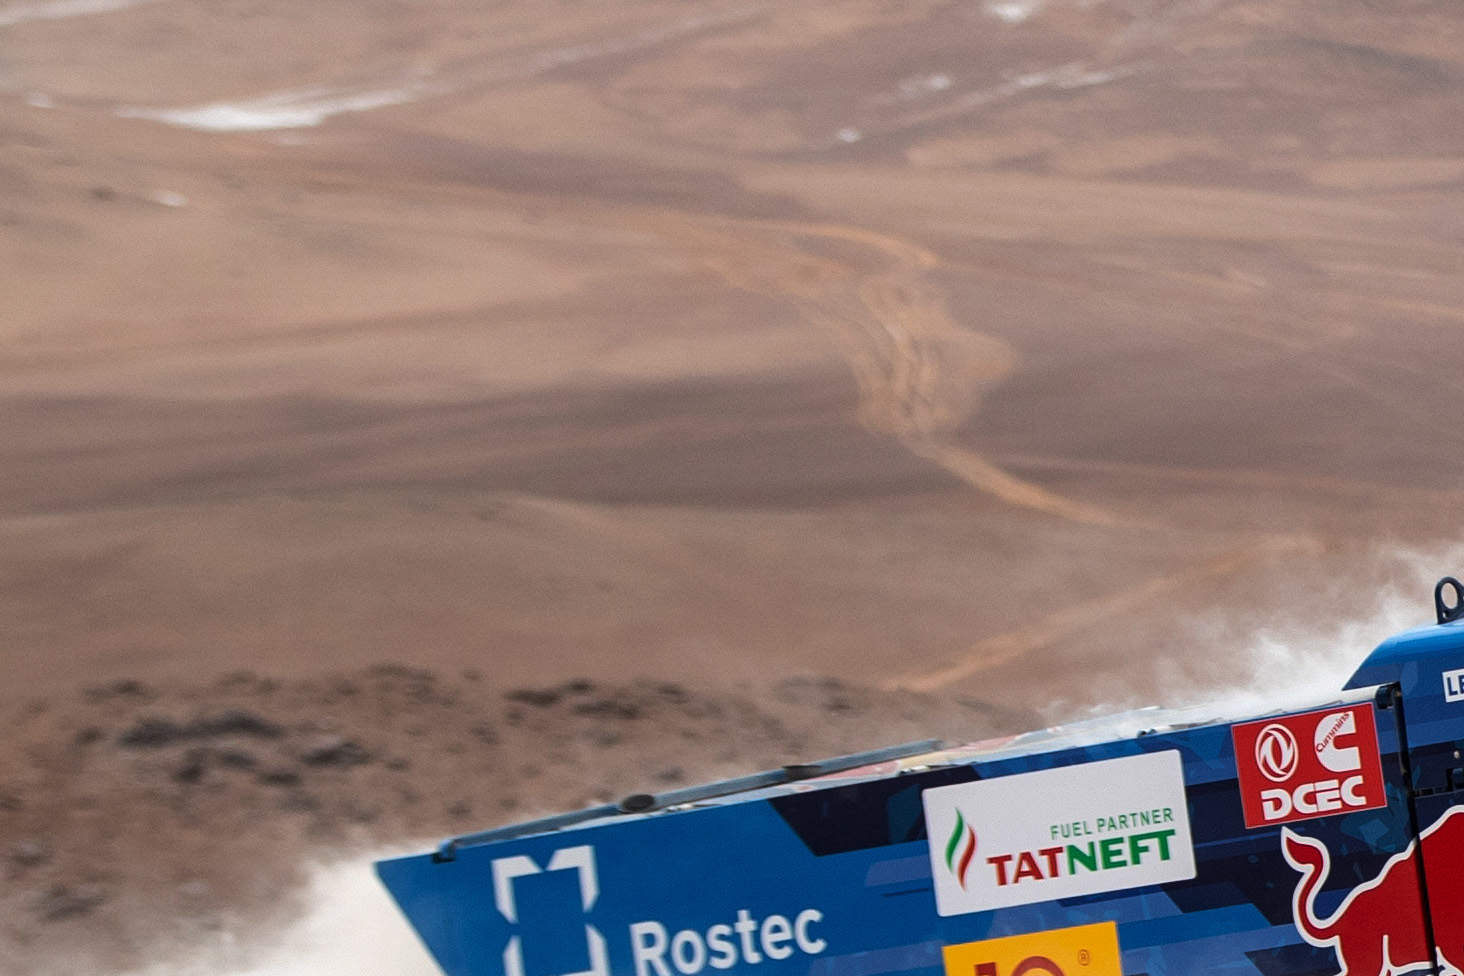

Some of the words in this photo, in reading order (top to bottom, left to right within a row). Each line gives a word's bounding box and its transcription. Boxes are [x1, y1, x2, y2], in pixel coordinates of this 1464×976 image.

[1315, 712, 1350, 753] Cummins
[1260, 775, 1367, 821] DCEC
[1050, 821, 1092, 841] FUEL
[1097, 807, 1174, 833] PARTNER
[986, 829, 1177, 887] TATNEFT
